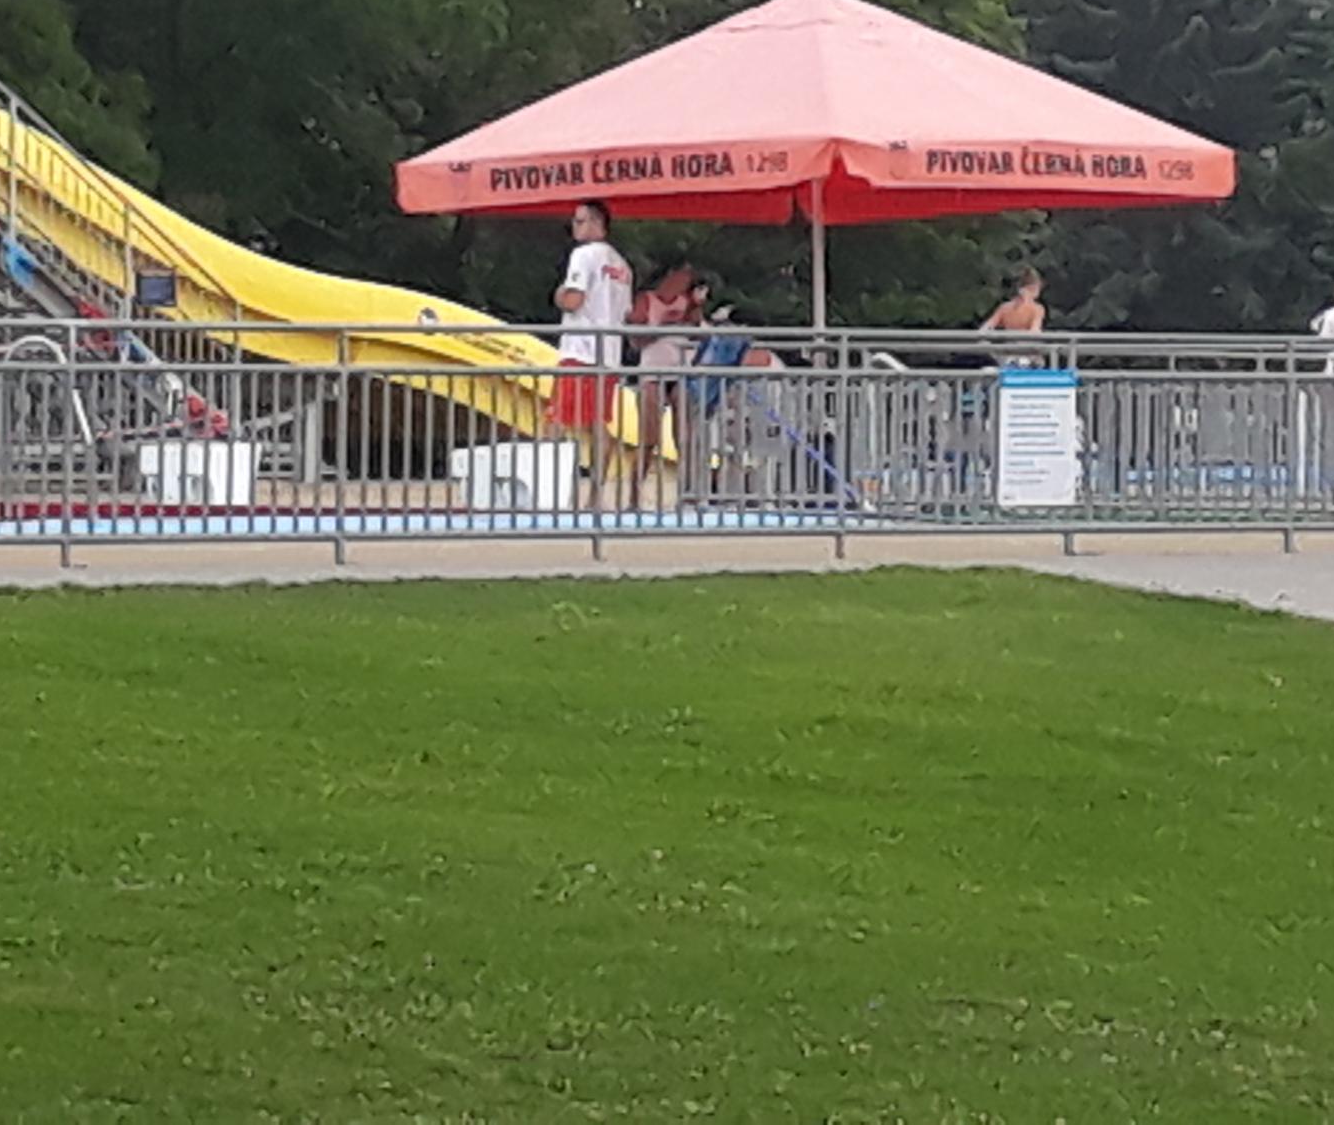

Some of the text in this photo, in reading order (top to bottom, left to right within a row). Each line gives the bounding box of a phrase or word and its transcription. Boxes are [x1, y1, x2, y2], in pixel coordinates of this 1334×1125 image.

[490, 161, 584, 192] PIVOVAR
[591, 151, 663, 183] ČERNÁ
[671, 151, 734, 179] HORA
[926, 149, 1014, 175] PIVOVAR
[1021, 146, 1086, 178] ČERNÁ
[1091, 154, 1147, 180] HORA
